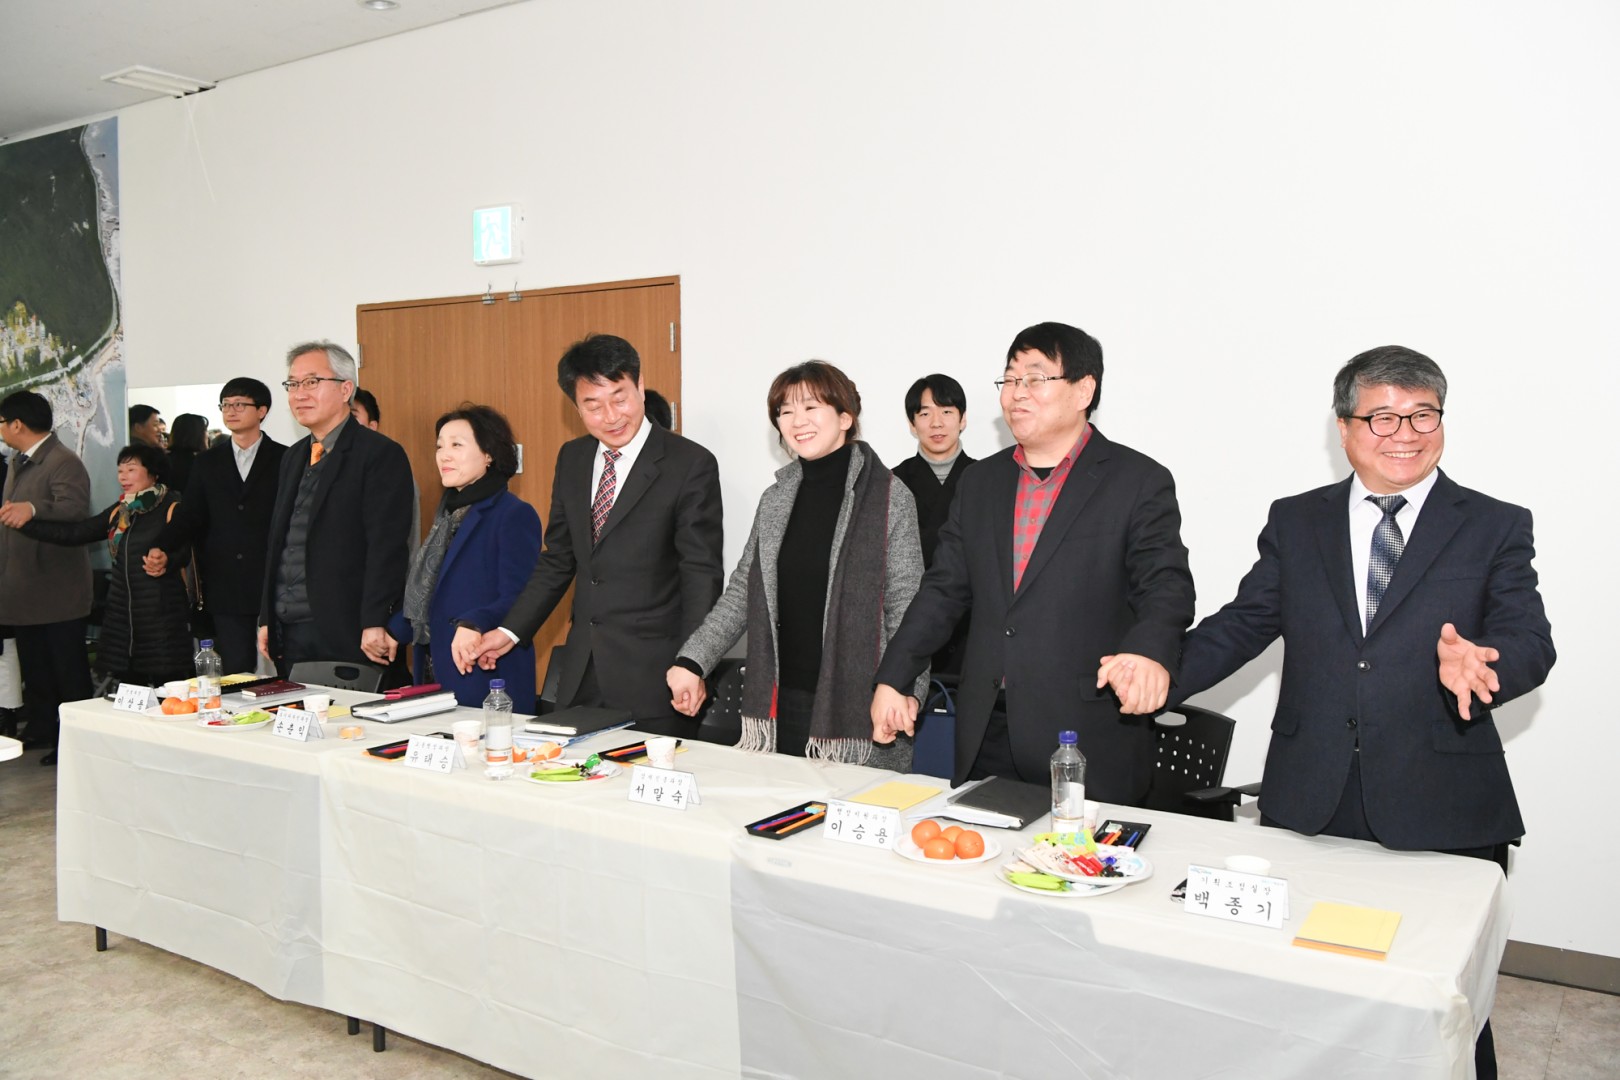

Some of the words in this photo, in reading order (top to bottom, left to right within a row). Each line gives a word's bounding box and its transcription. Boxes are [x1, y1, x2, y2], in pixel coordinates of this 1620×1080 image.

[410, 750, 449, 770] 유태승
[635, 783, 683, 805] 서말숙
[831, 819, 888, 844] 이승용
[1194, 890, 1272, 921] 백종기
